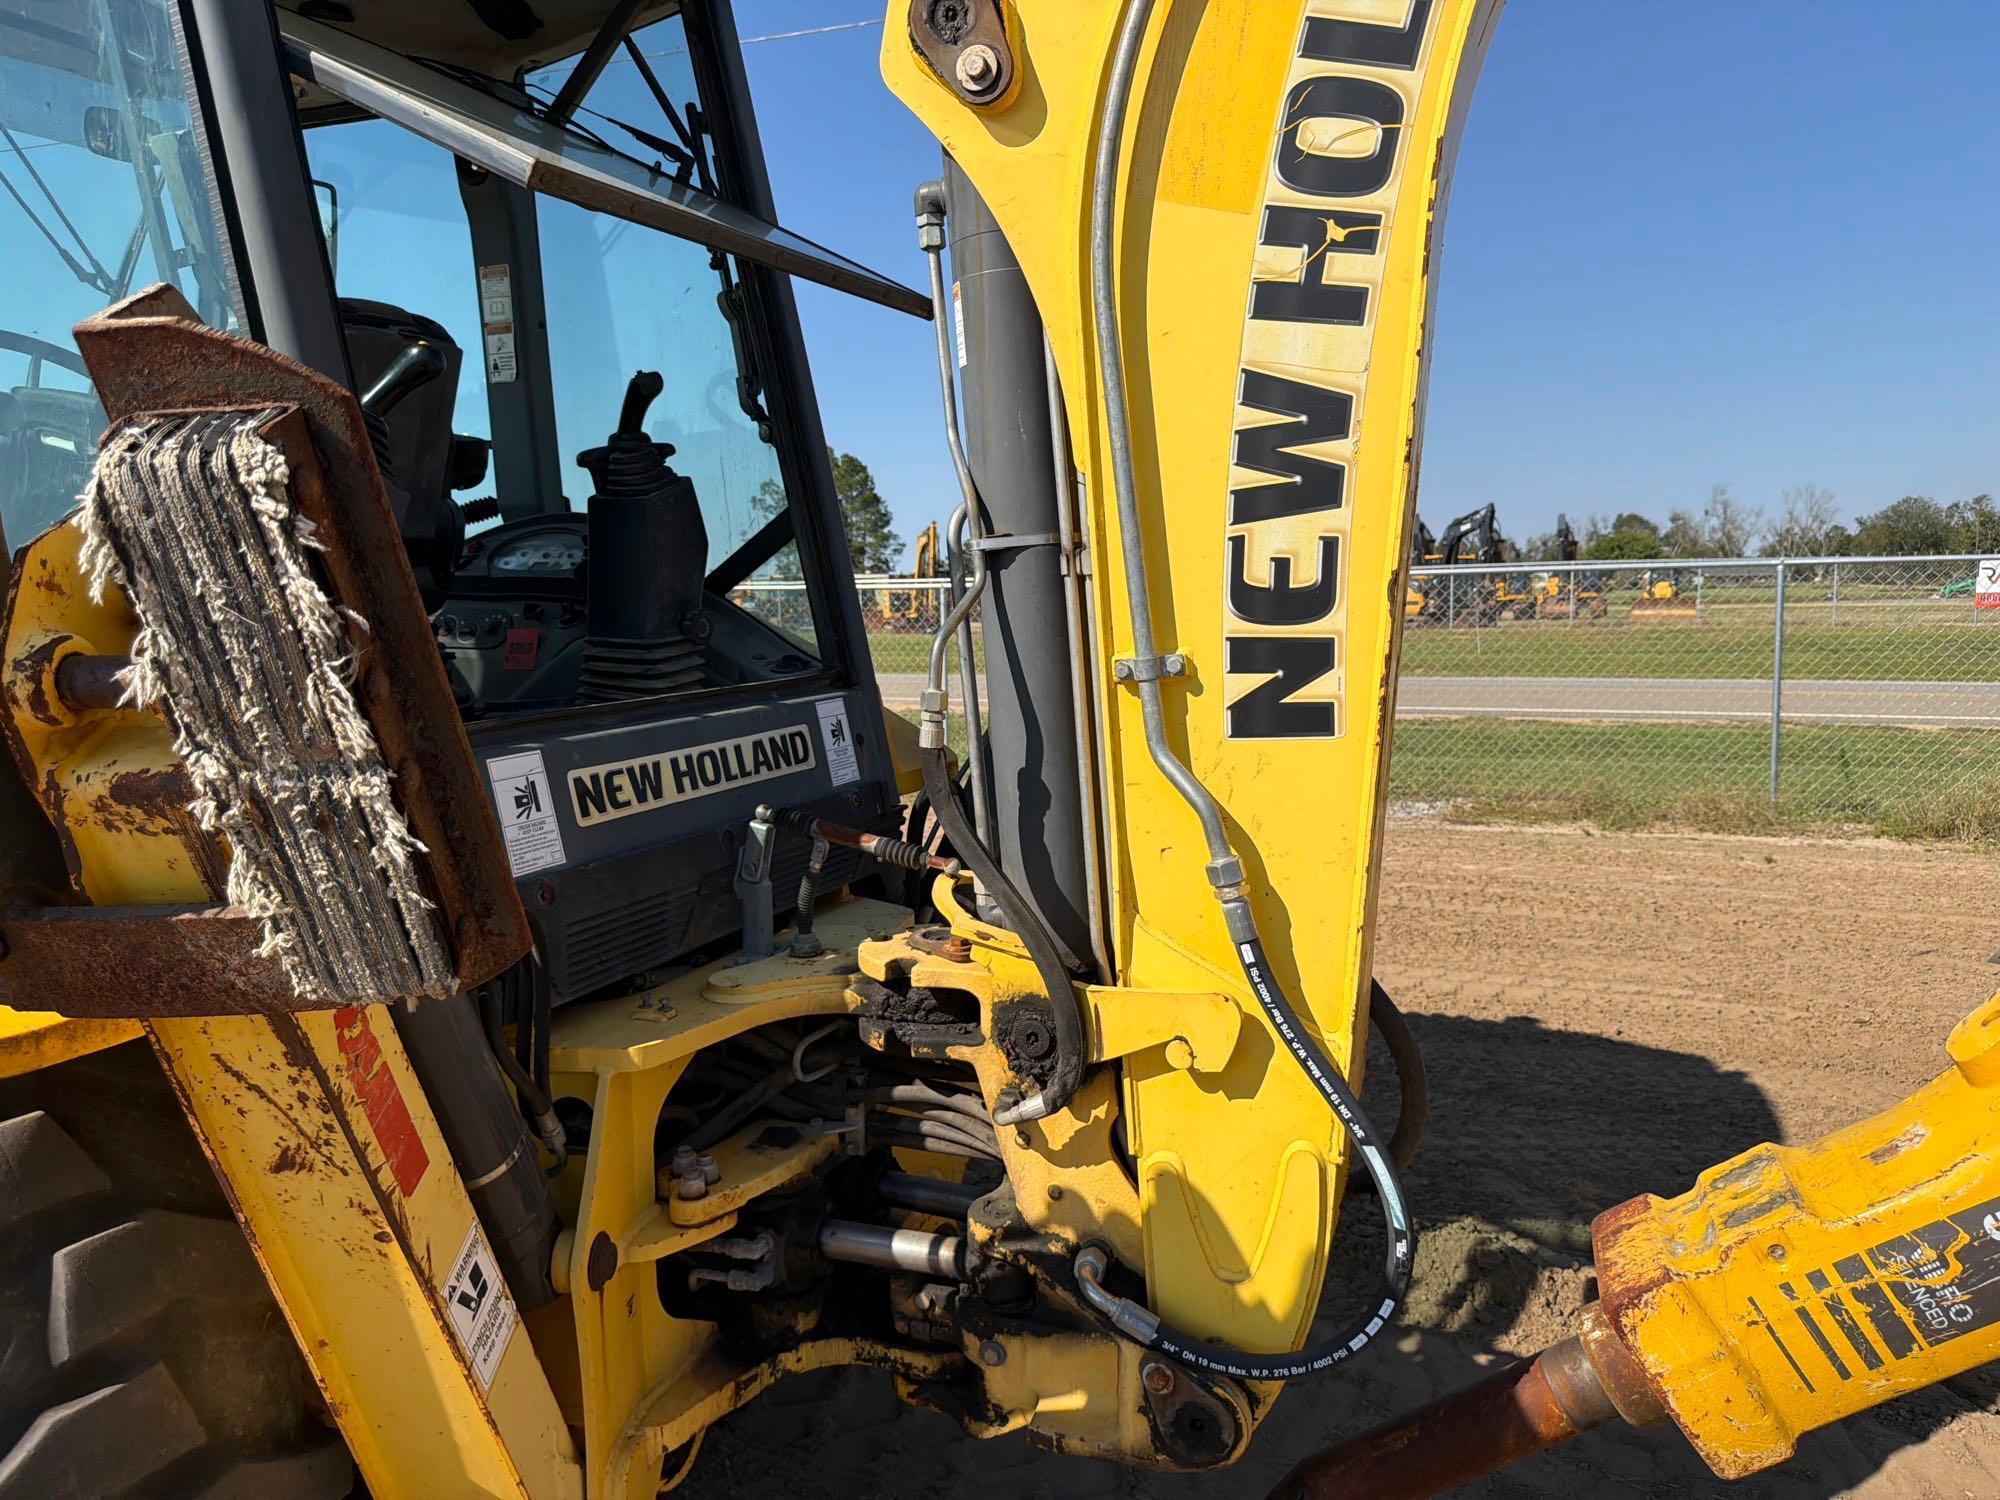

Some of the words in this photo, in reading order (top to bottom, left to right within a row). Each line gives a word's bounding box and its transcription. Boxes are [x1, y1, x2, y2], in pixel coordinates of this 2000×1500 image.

[1227, 368, 1354, 740] NEW
[572, 760, 664, 820] NEW
[669, 730, 810, 795] HOLLAND
[1249, 967, 1262, 983] PSI
[1257, 982, 1272, 1003] 4002
[1271, 1008, 1285, 1024] Bar
[1280, 1023, 1295, 1040] 276
[1306, 1057, 1322, 1079] Max.
[1319, 1077, 1334, 1094] mm
[1330, 1093, 1341, 1106] 19
[1338, 1104, 1352, 1119] DN
[454, 1233, 480, 1284] WARNING
[471, 1317, 490, 1354] PINCH
[486, 1286, 504, 1318] POINT
[481, 1305, 503, 1351] HAZARD
[481, 1338, 497, 1365] Keep
[1182, 1350, 1197, 1363] DN
[1198, 1356, 1209, 1367] 19
[1209, 1361, 1227, 1373] mm
[1227, 1364, 1250, 1377] Max.
[1251, 1368, 1272, 1378] W.P.
[1273, 1367, 1289, 1377] 276
[1290, 1365, 1307, 1375] Bar
[1313, 1356, 1334, 1370] 4002
[1332, 1347, 1349, 1361] PSI
